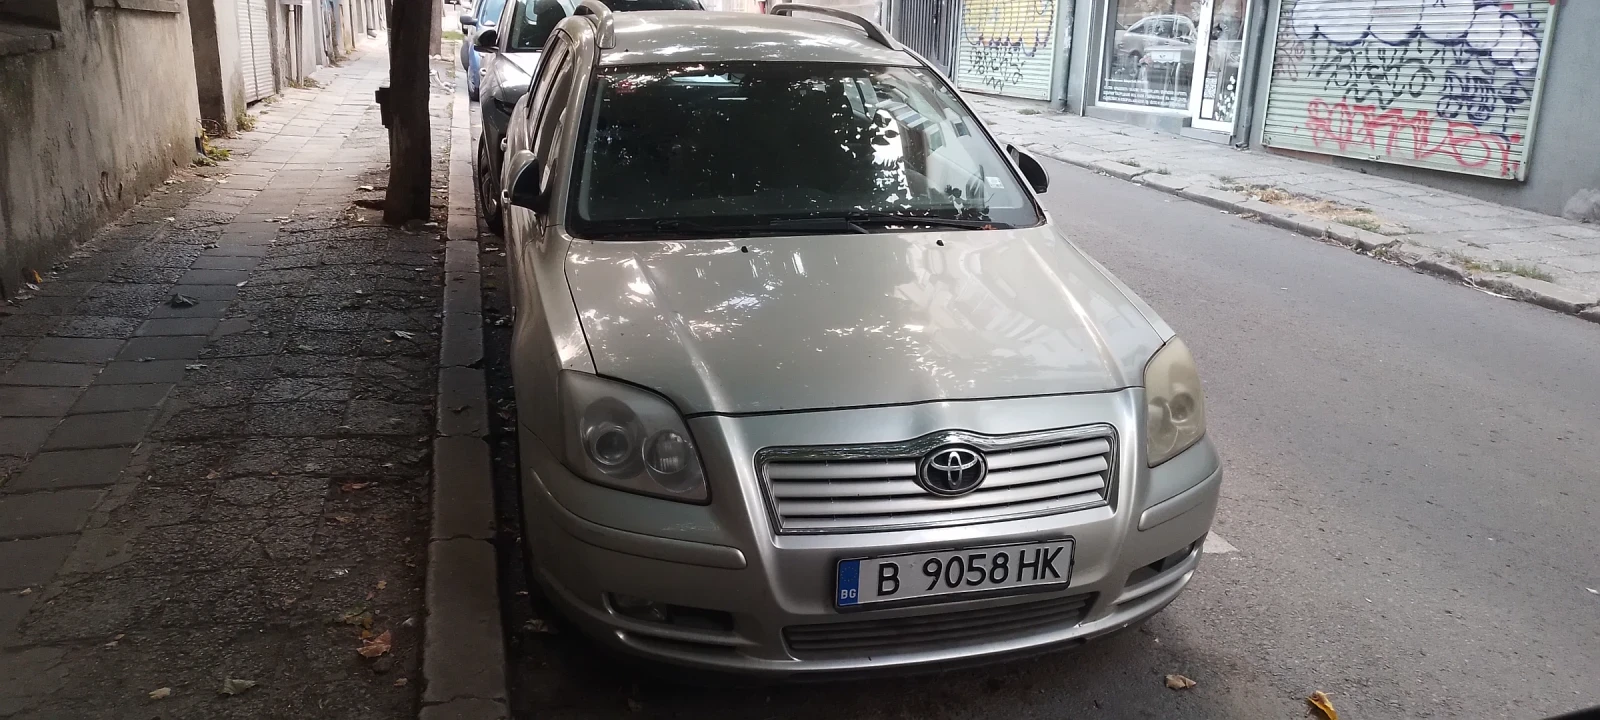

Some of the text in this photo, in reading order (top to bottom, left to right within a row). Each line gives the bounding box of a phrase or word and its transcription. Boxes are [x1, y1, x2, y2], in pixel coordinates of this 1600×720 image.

[877, 546, 1064, 597] B 9058 HK
[840, 589, 856, 600] BG
